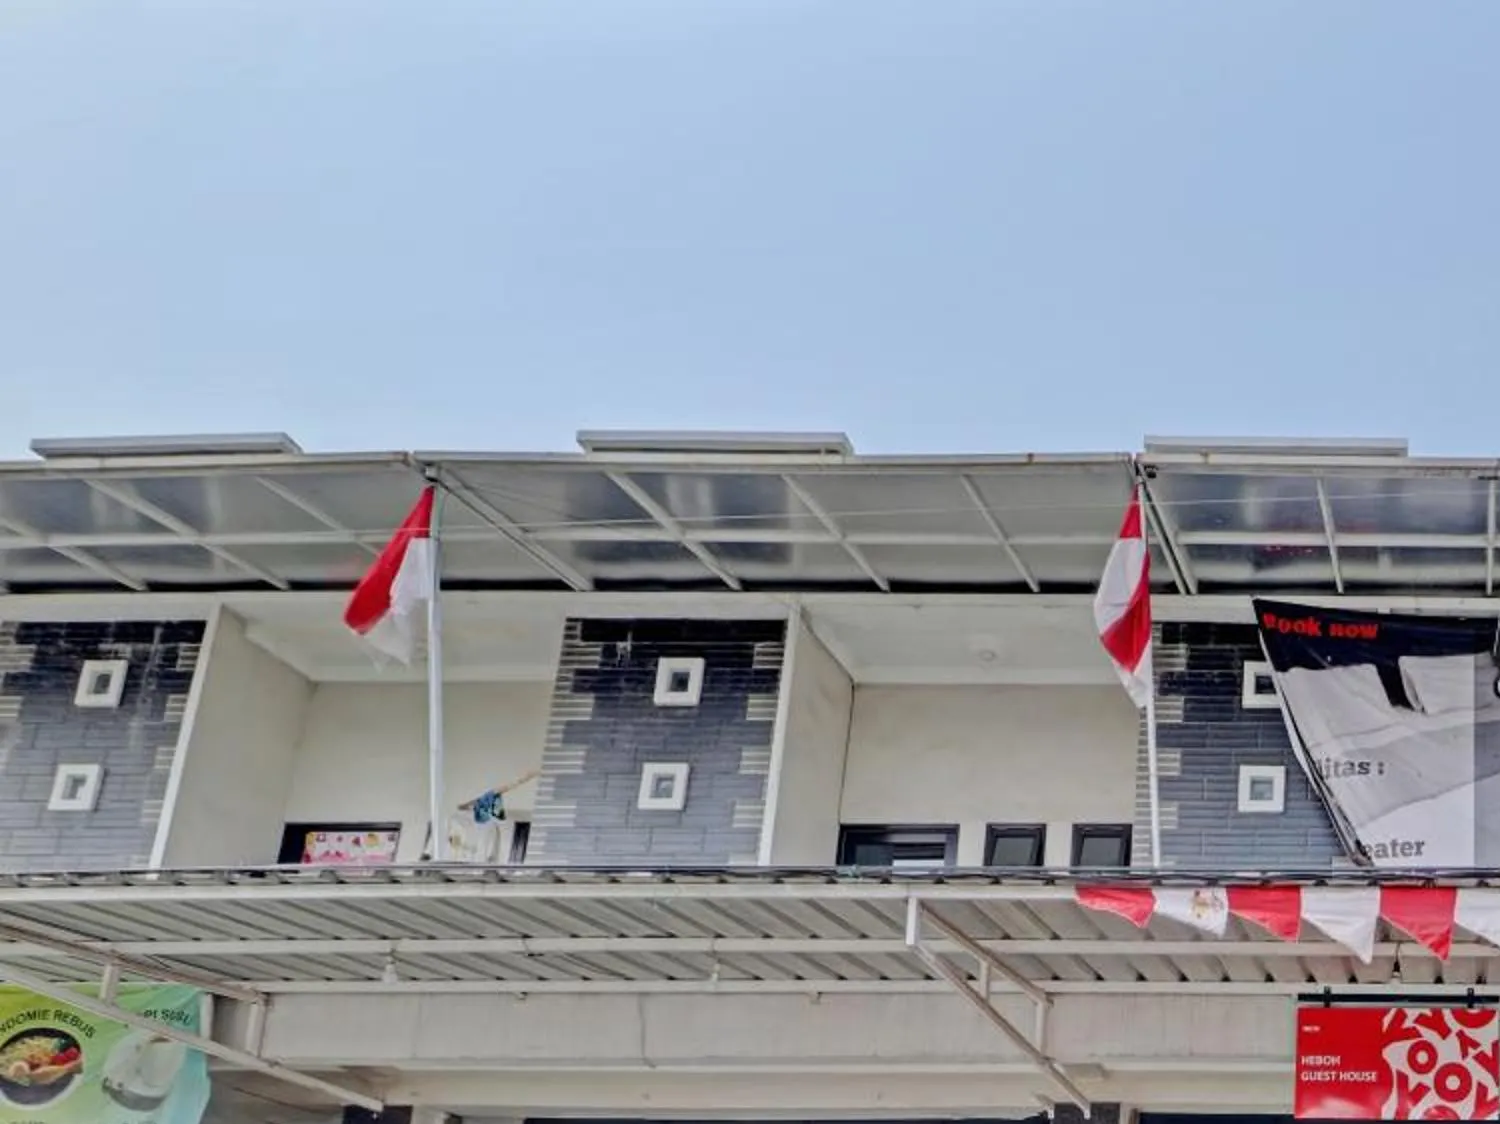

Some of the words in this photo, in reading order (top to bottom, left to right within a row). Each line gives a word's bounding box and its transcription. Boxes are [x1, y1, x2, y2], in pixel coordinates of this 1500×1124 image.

[53, 1009, 97, 1039] REBUS
[1301, 1055, 1342, 1067] HEBOH
[1301, 1070, 1337, 1082] GUEST
[1339, 1071, 1378, 1082] HOUSE
